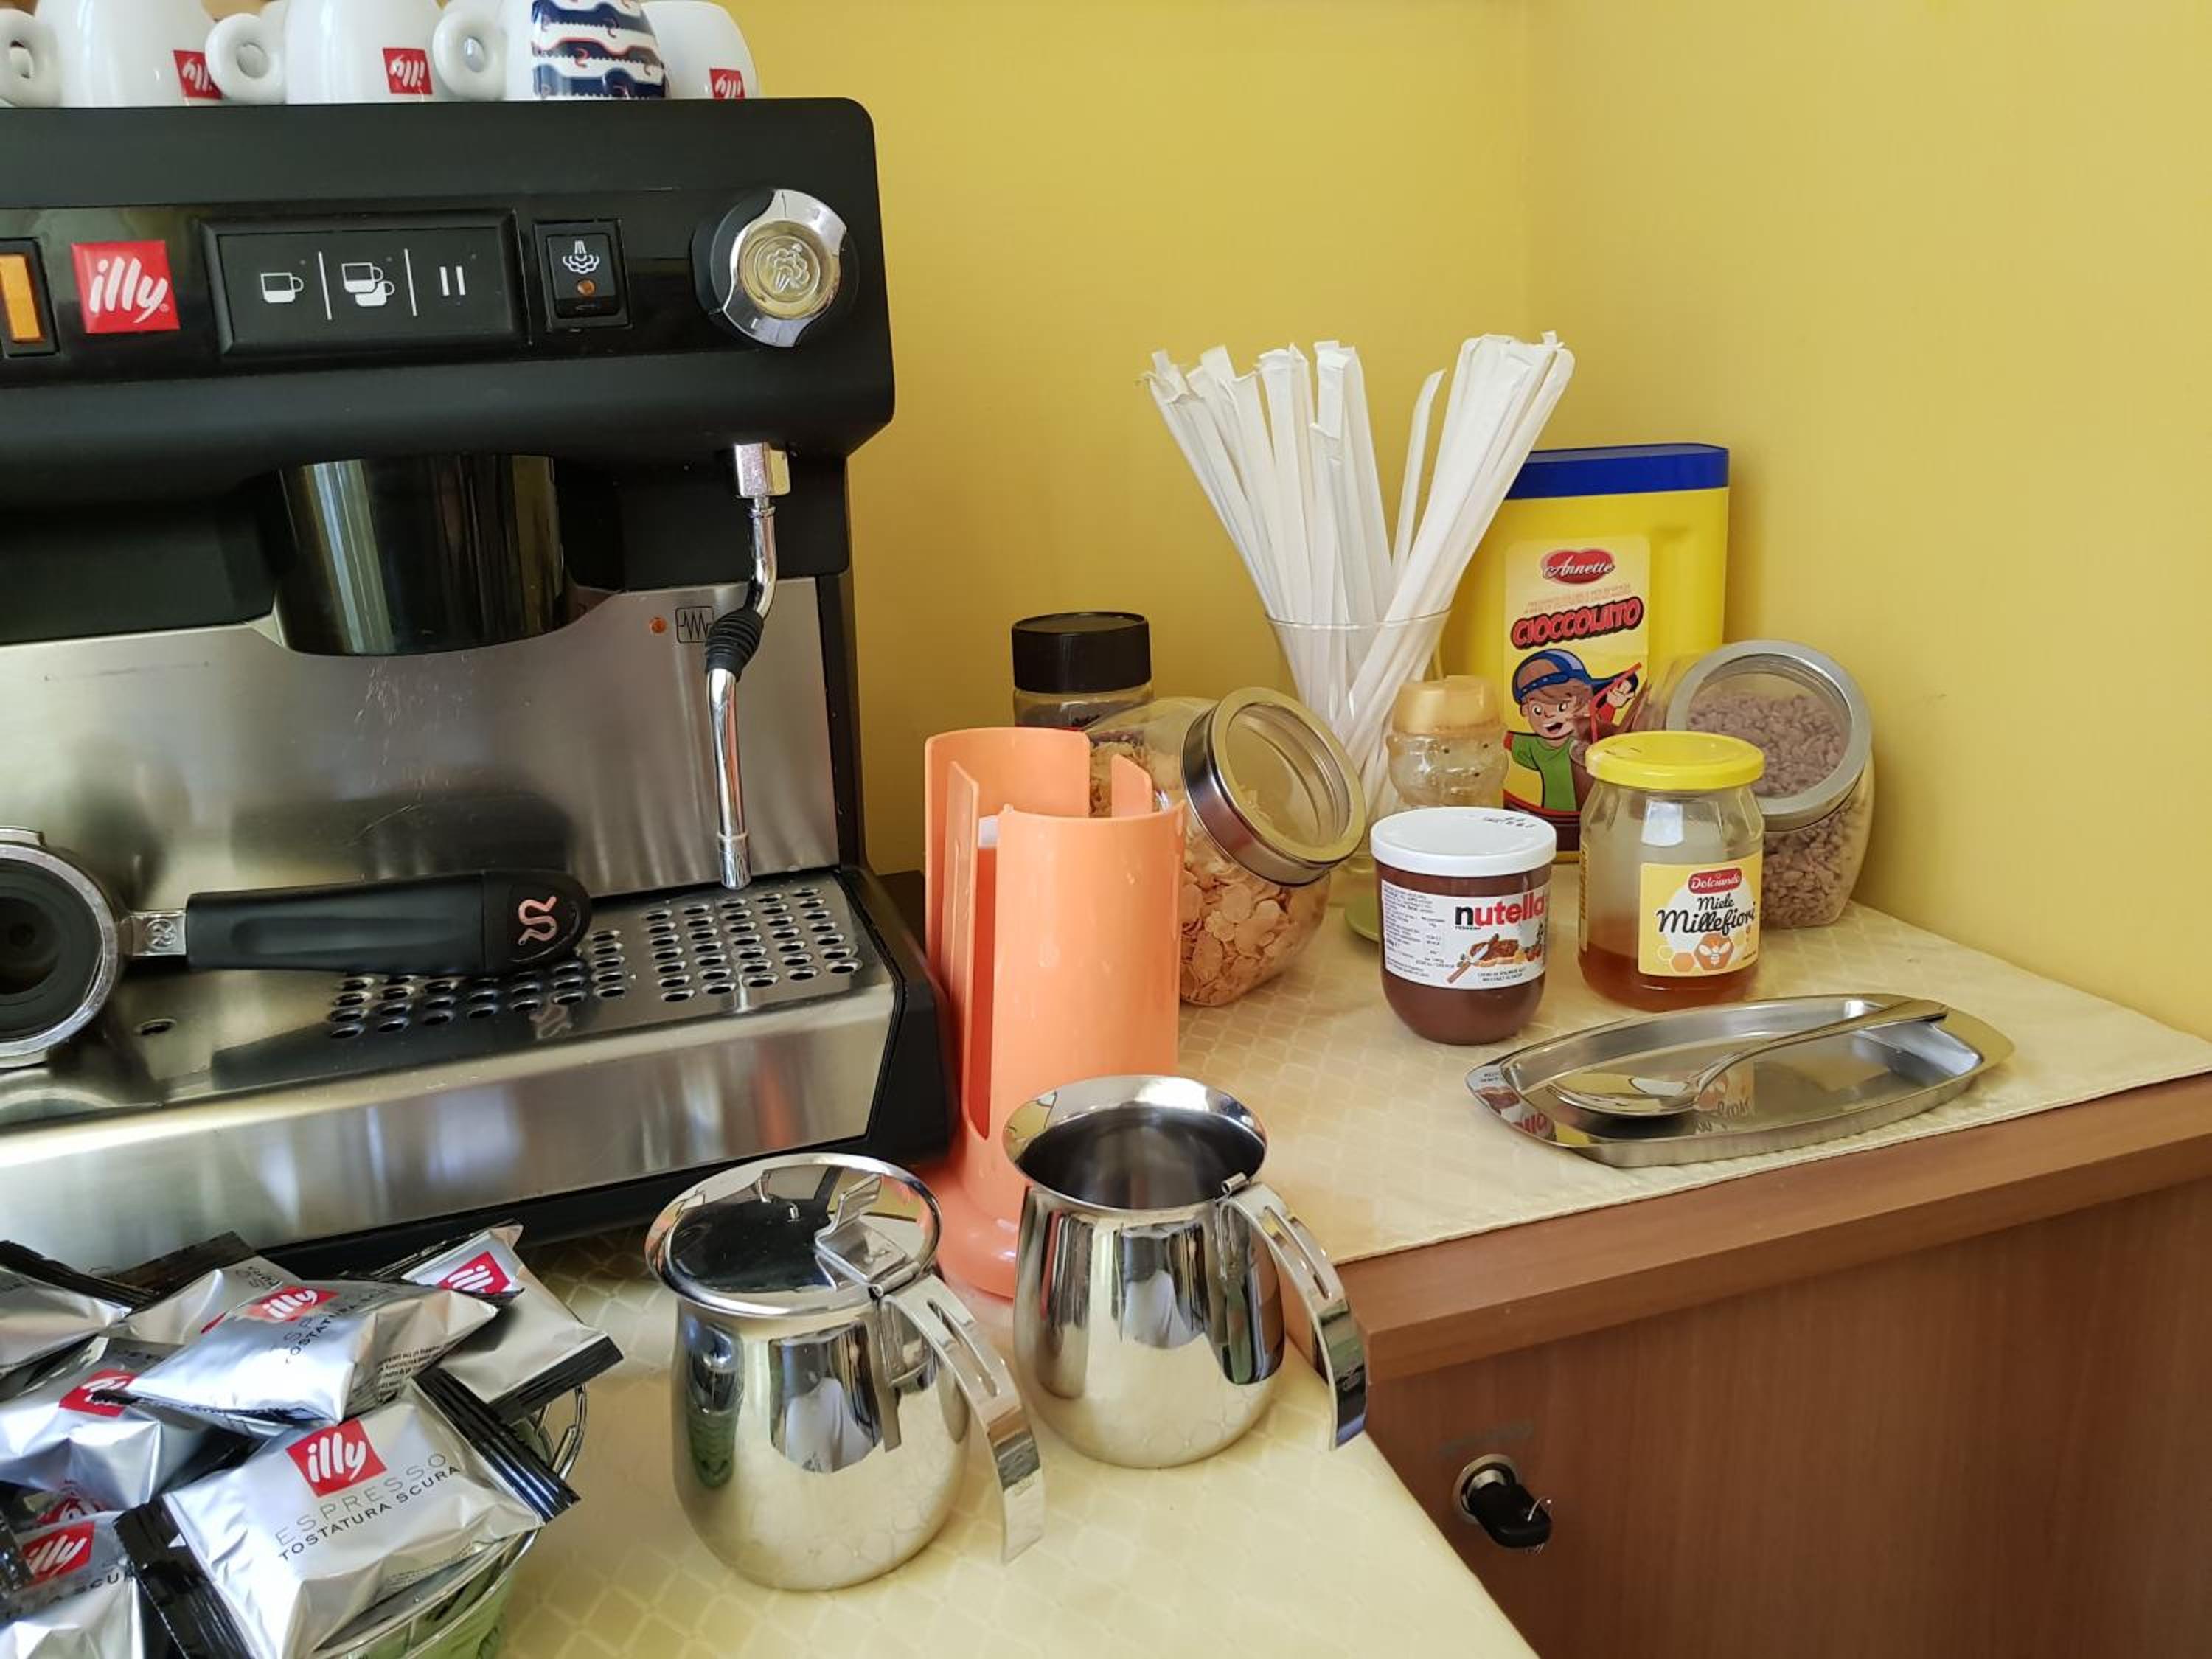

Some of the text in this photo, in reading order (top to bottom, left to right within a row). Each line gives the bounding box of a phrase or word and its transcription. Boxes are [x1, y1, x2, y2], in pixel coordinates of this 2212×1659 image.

[1543, 554, 1615, 579] Annette
[1512, 597, 1644, 649] CIOCCOLATO
[1455, 891, 1545, 927] nutella
[1656, 902, 1756, 936] Millefiori
[1697, 892, 1734, 911] Miele
[448, 1265, 494, 1291] ill
[262, 1290, 318, 1319] illy
[307, 1432, 366, 1483] illy
[275, 1453, 447, 1546] ESPRESSO
[279, 1465, 461, 1562] TOSTATURA SCURA
